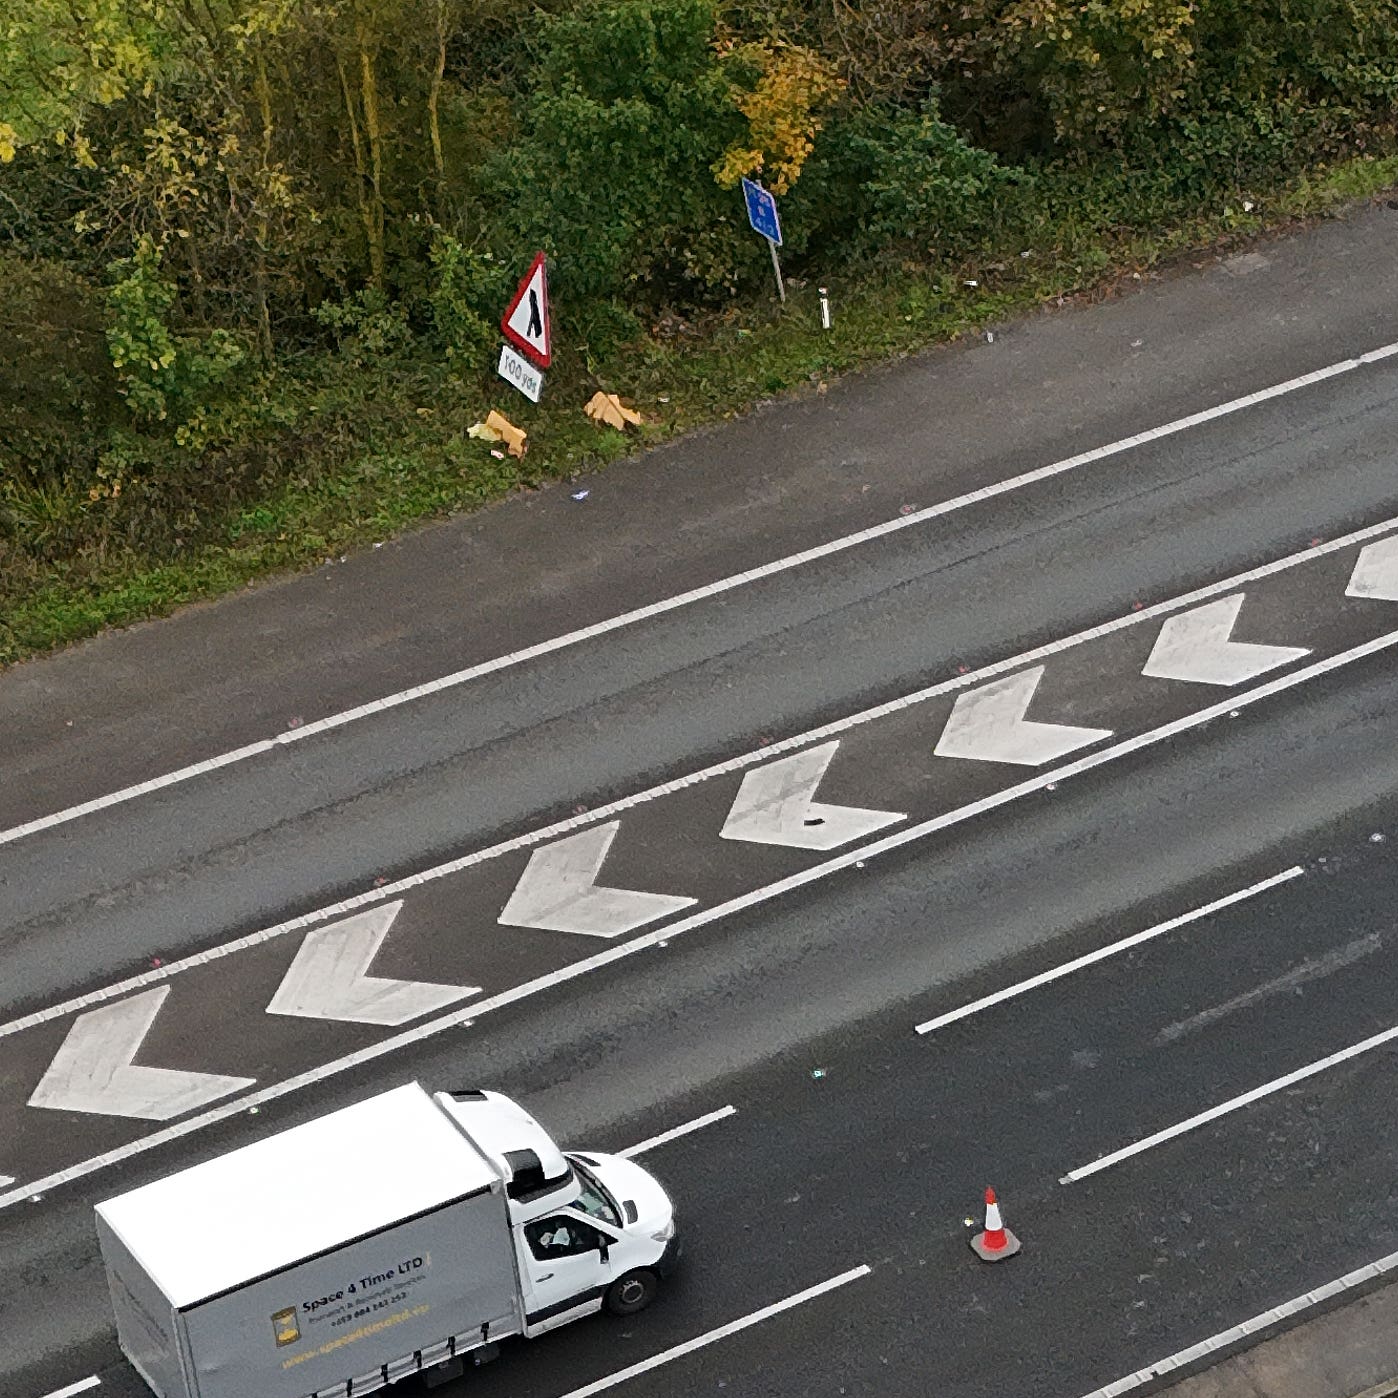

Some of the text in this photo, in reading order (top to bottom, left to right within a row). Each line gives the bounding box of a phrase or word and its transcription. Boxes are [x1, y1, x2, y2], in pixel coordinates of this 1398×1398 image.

[504, 354, 537, 393] 100 yds
[302, 1256, 424, 1313] Space 4 Time LTD
